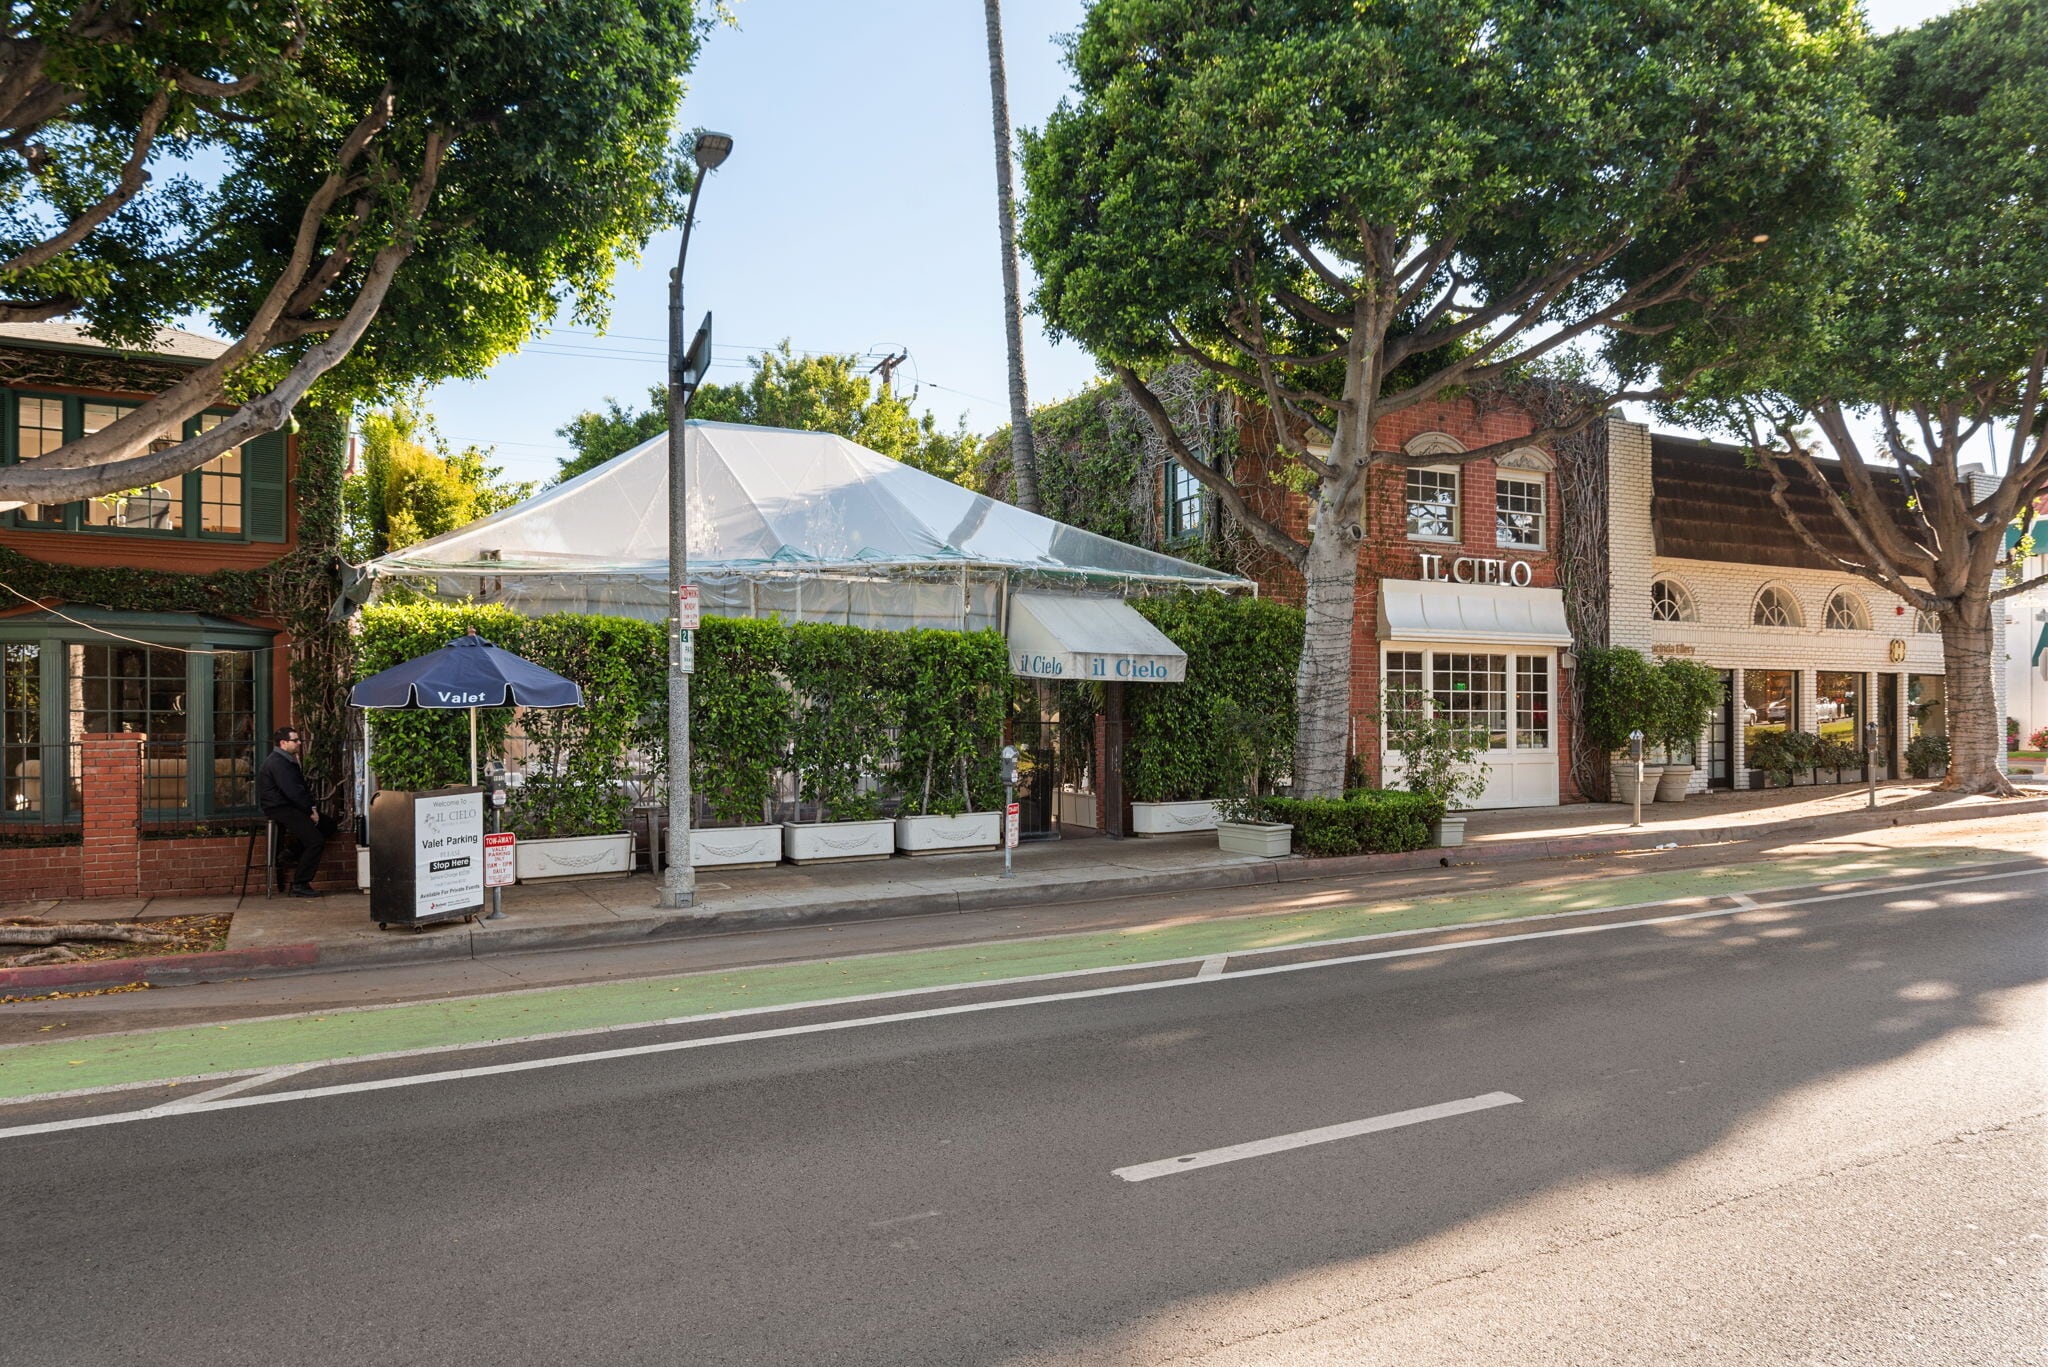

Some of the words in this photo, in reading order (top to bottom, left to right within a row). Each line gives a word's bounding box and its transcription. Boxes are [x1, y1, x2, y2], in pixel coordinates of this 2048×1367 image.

[1419, 553, 1449, 582] IL
[1453, 557, 1532, 587] CIELO
[1651, 643, 1675, 654] ucinda
[1020, 654, 1028, 673] il
[1033, 655, 1063, 675] Cielo
[1092, 658, 1106, 676] il
[1115, 658, 1168, 679] Cielo
[437, 691, 486, 704] Valet
[432, 800, 460, 808] Welcome
[435, 812, 446, 822] IL
[448, 808, 477, 821] CIELO
[422, 838, 444, 849] Valet
[446, 834, 478, 846] Parking
[485, 835, 513, 846] TOW-AWAY
[440, 849, 461, 858] PLEASE
[432, 861, 450, 870] Stop
[451, 858, 470, 867] Here
